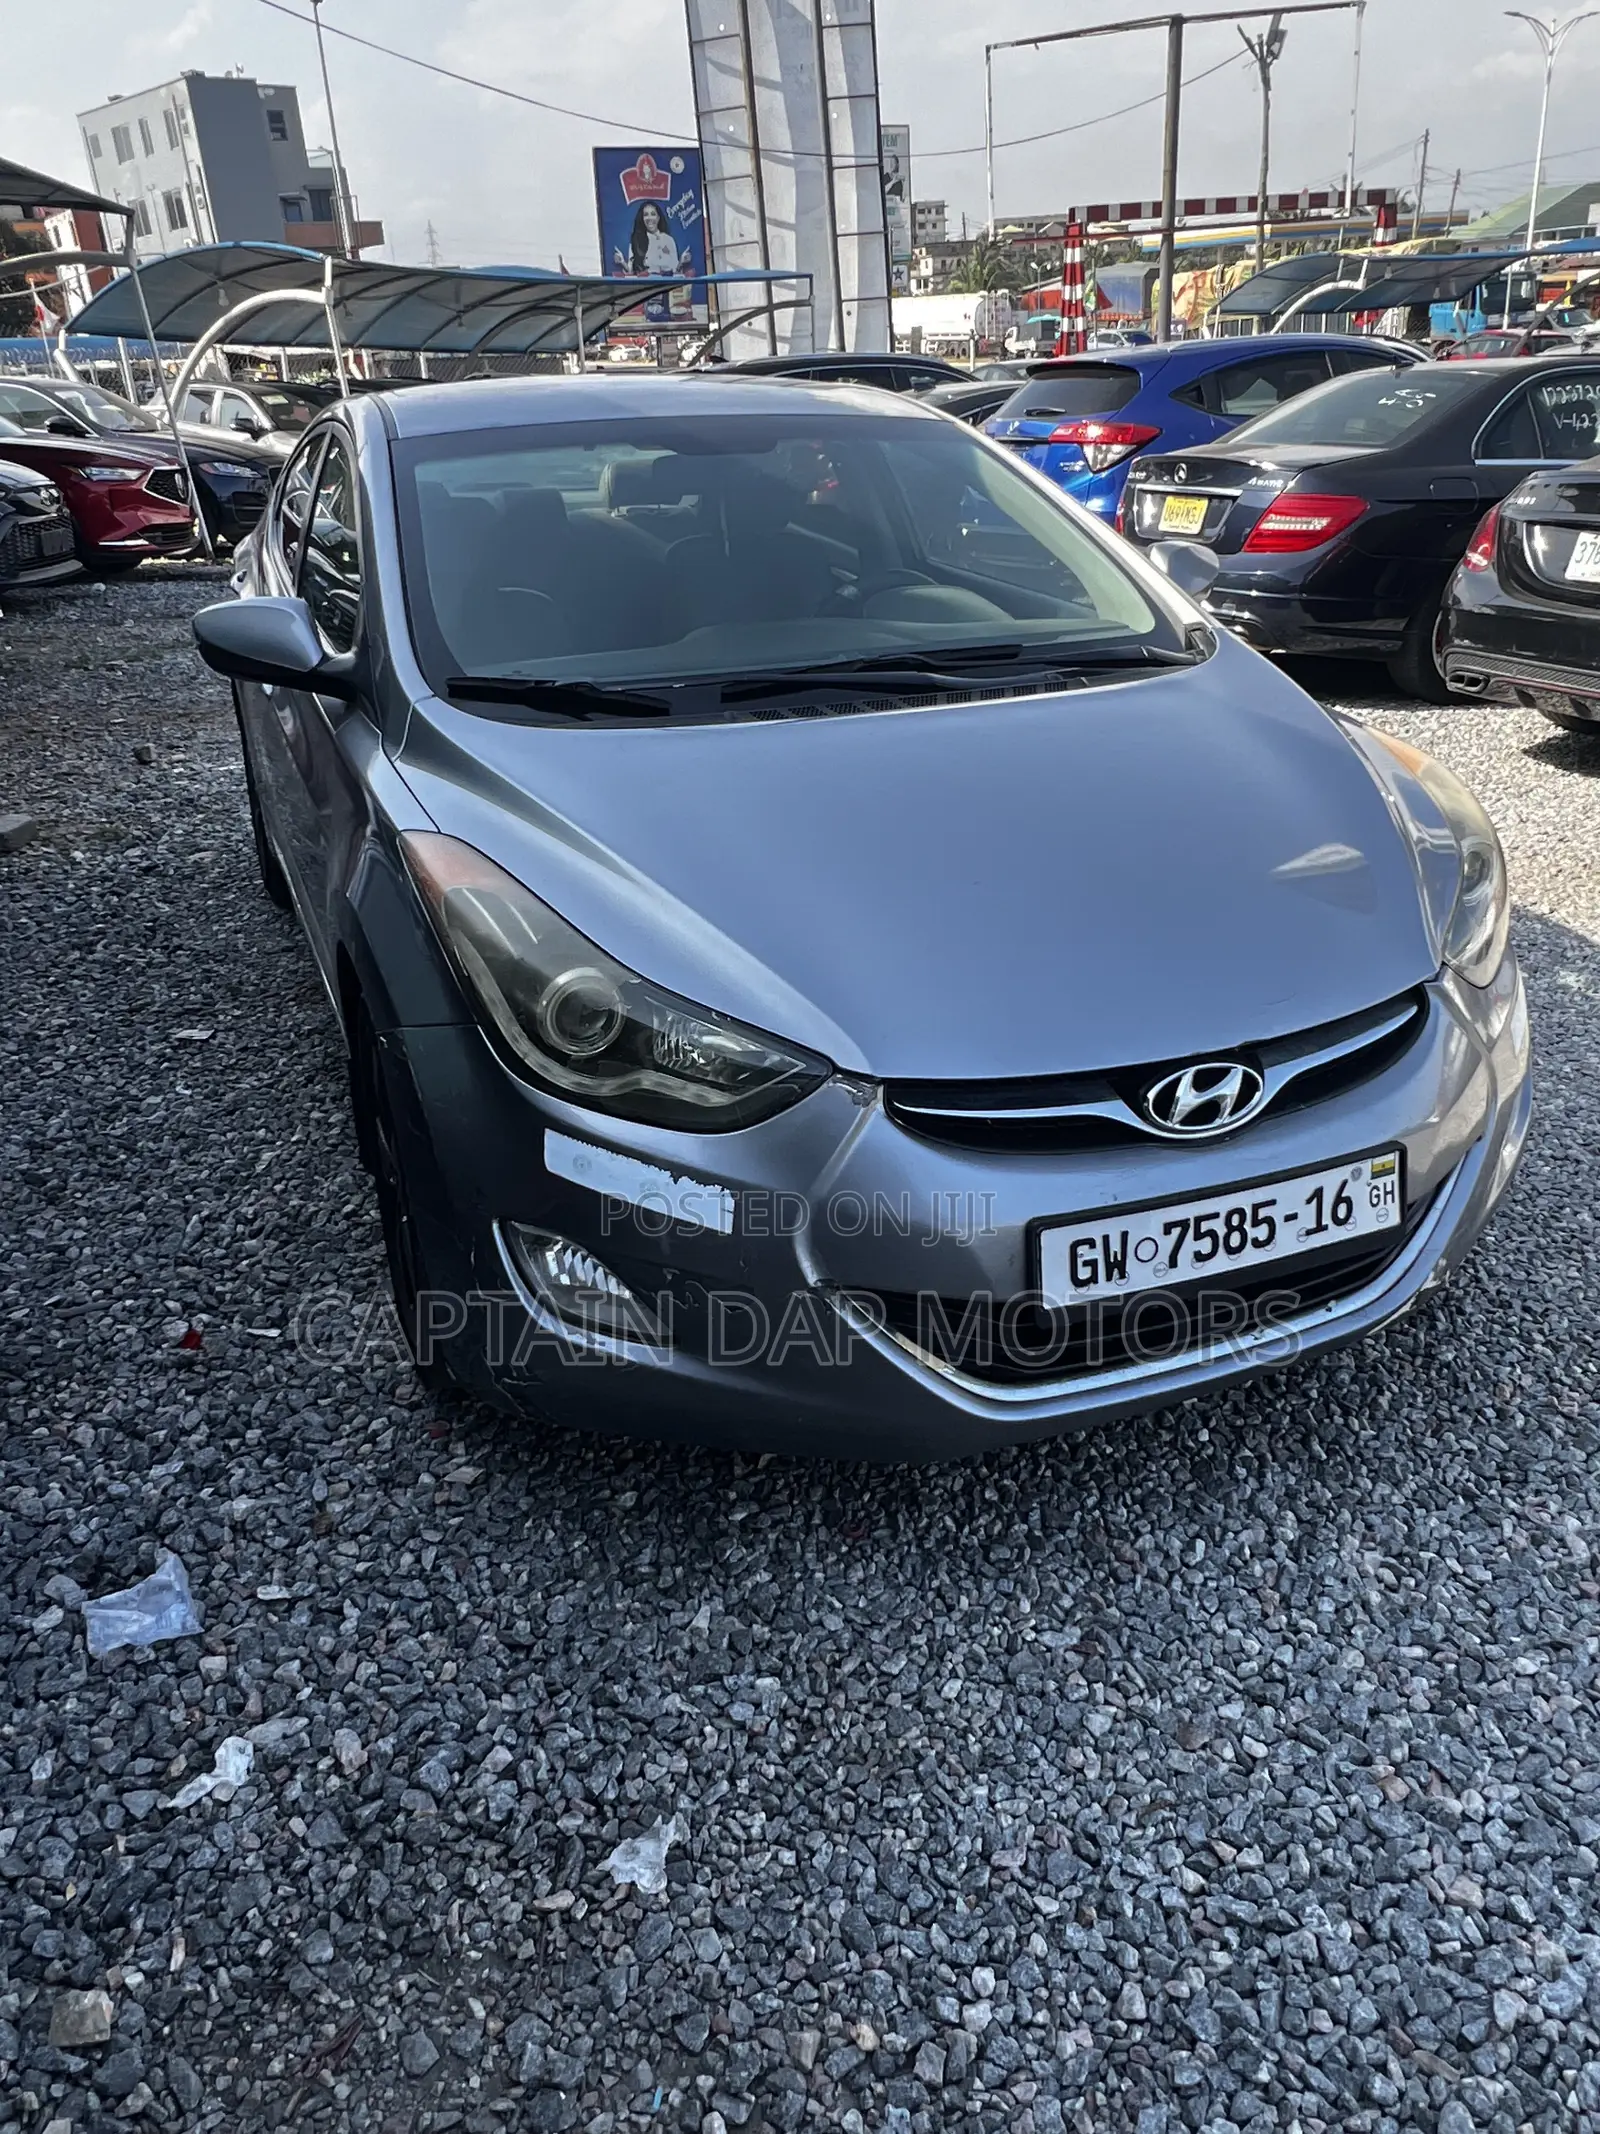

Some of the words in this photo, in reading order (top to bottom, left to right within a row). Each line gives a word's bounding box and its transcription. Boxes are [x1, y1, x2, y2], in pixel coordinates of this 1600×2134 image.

[1369, 1180, 1396, 1208] GH
[1069, 1230, 1130, 1289] GW
[1163, 1179, 1354, 1269] 7585-16
